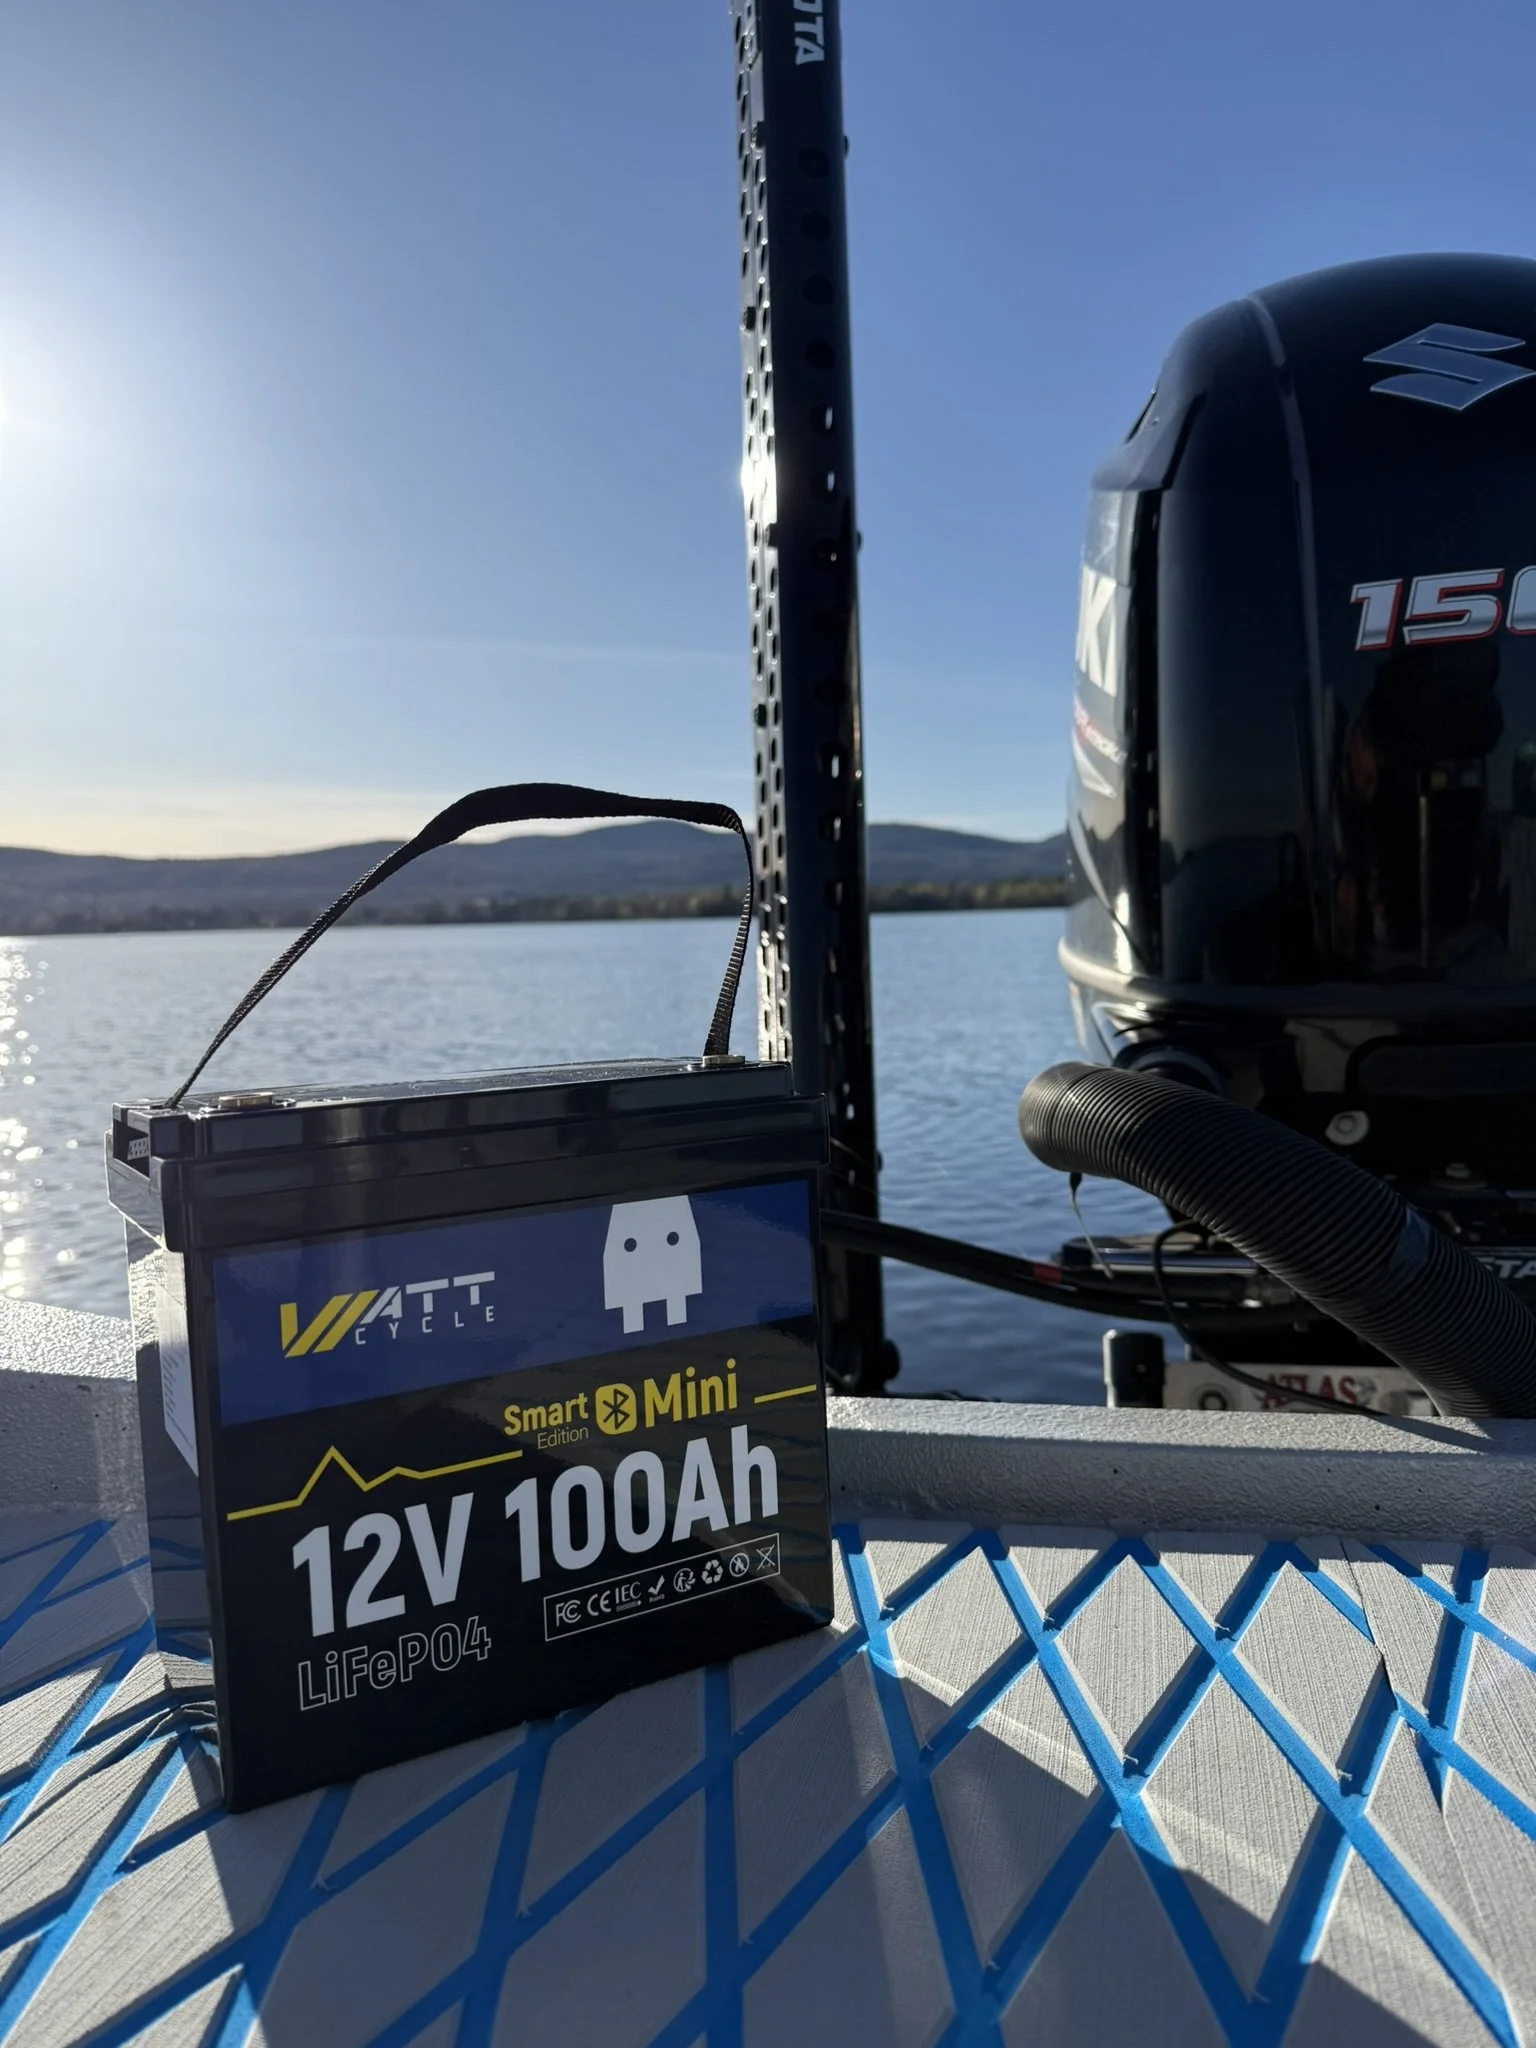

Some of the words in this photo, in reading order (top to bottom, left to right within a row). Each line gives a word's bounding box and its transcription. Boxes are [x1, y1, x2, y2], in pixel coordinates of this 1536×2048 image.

[280, 1271, 495, 1358] WATT
[355, 1305, 495, 1345] CYCLE
[504, 1392, 589, 1436] Smart
[643, 1358, 738, 1429] Mini
[537, 1427, 589, 1450] Edition
[292, 1492, 474, 1637] 12V
[504, 1424, 779, 1583] 100Ah
[587, 1590, 612, 1616] CE
[615, 1581, 642, 1604] IEC
[298, 1616, 492, 1711] LiFePO4
